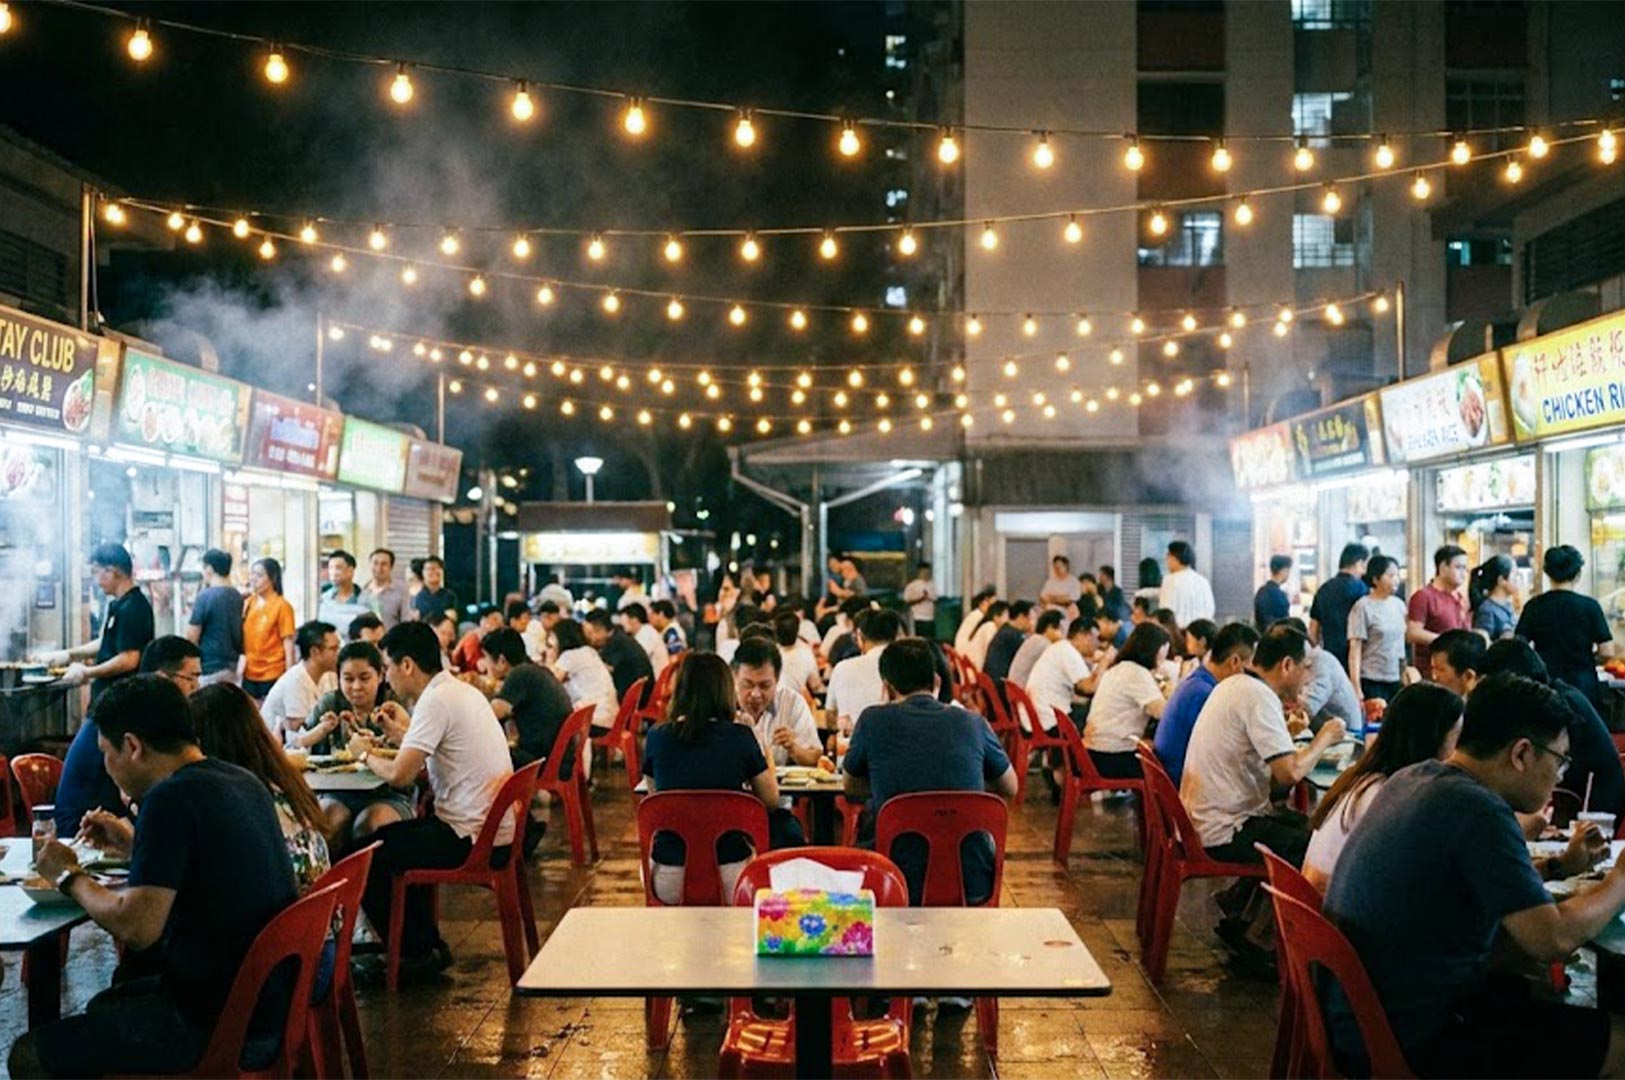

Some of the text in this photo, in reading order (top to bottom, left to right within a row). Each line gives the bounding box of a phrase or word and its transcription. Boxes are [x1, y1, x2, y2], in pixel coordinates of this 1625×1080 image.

[30, 330, 75, 373] CLUB
[1542, 383, 1625, 424] CHICKEN RI
